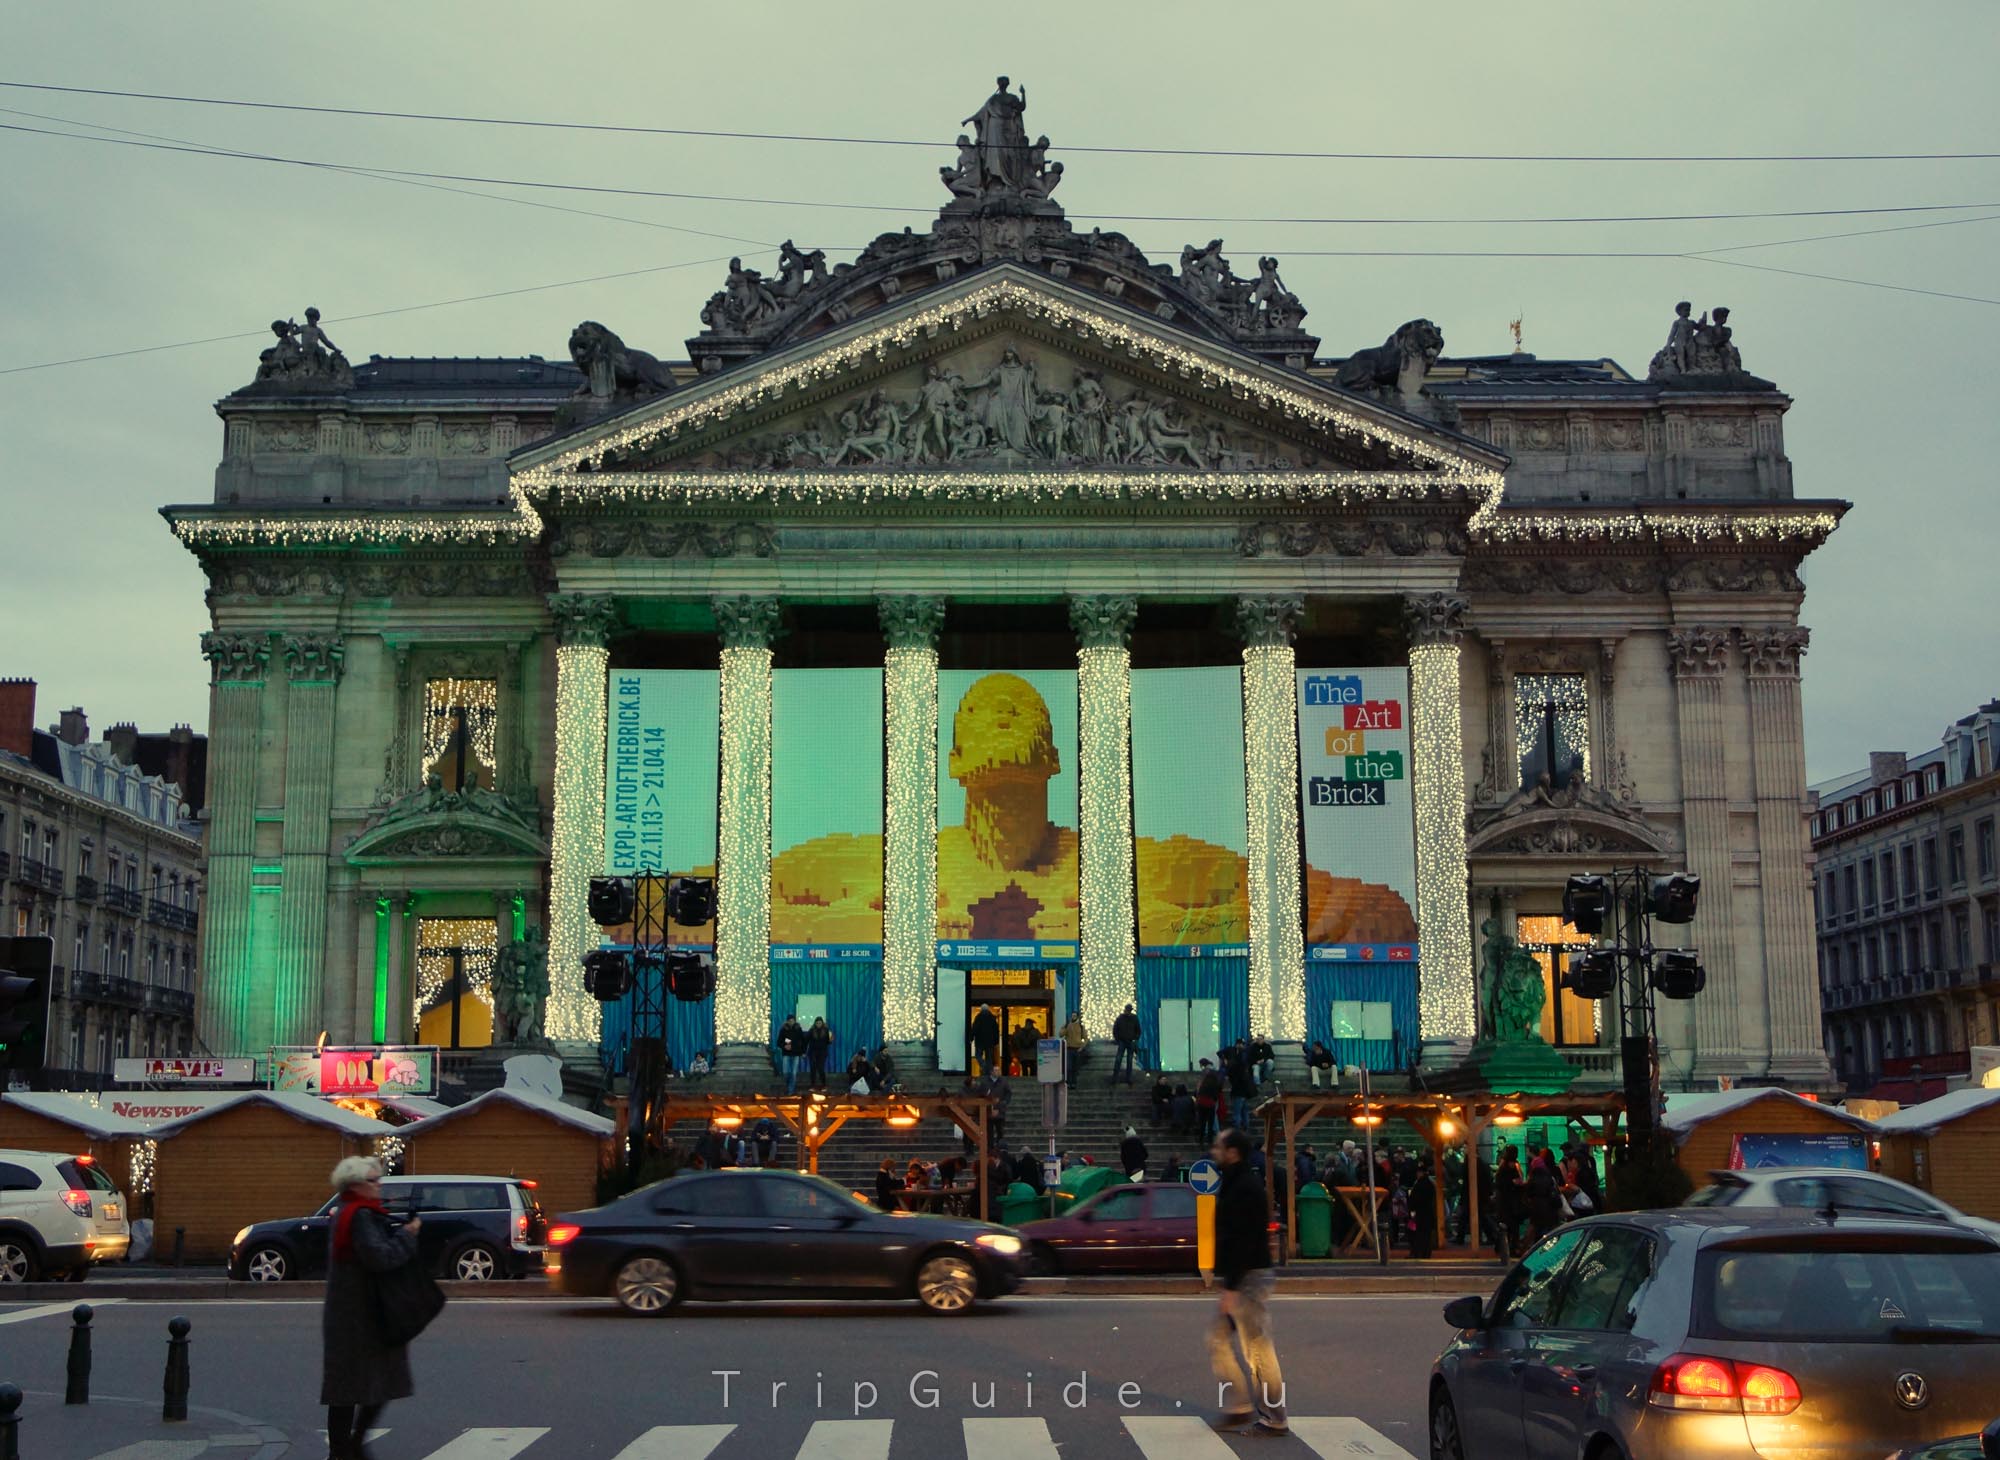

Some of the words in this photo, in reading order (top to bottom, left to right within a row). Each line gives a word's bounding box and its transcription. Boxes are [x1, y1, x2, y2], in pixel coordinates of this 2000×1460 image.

[1309, 683, 1357, 703] The
[1353, 707, 1392, 729] Art
[1332, 732, 1356, 754] of
[642, 727, 666, 789] 21.04.14
[1354, 758, 1394, 779] the
[613, 677, 641, 869] EXPO-ARTOFTHEBRICK.BE
[1316, 783, 1378, 804] Brick
[640, 811, 664, 870] 22.11.13
[181, 1060, 223, 1077] VIF
